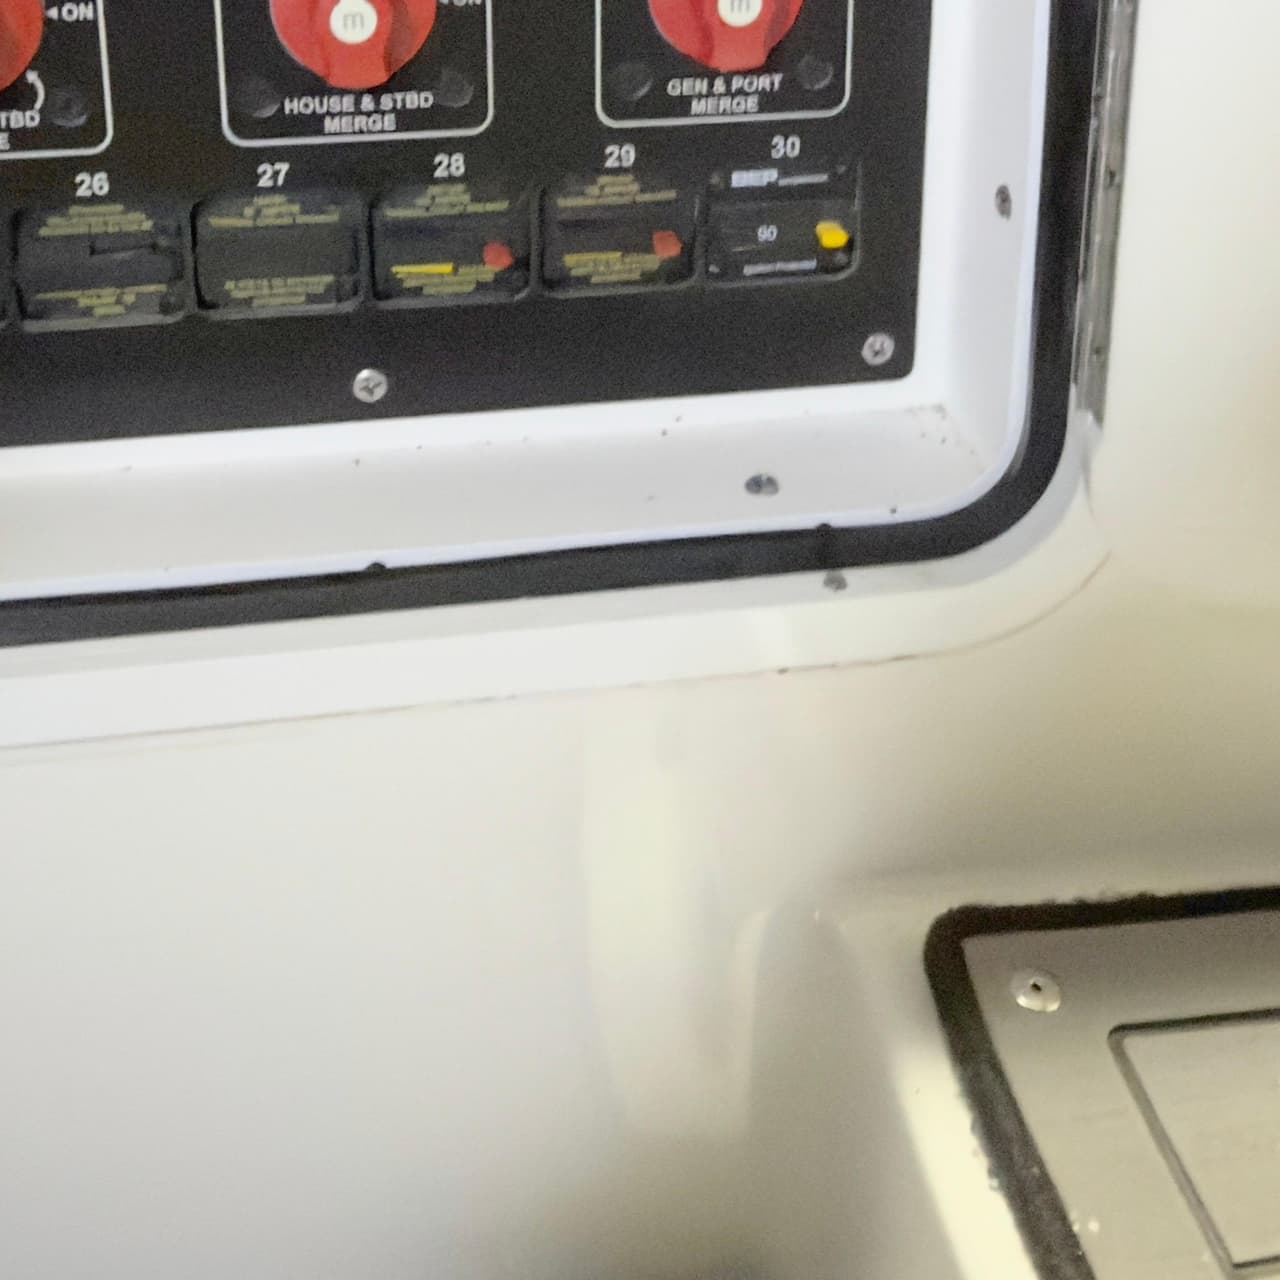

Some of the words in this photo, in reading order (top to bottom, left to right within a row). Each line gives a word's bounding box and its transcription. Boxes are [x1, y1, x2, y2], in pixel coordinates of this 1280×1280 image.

[61, 1, 94, 21] ON
[667, 76, 708, 96] GEN
[713, 76, 726, 94] &
[731, 72, 783, 93] PORT
[284, 93, 355, 114] HOUSE
[360, 94, 375, 112] &
[380, 91, 433, 110] STBD
[690, 95, 759, 115] MERGE
[324, 113, 396, 133] MERGE
[604, 144, 636, 168] 29
[771, 136, 801, 159] 30
[257, 163, 289, 187] 27
[434, 153, 465, 178] 28
[74, 173, 109, 196] 26
